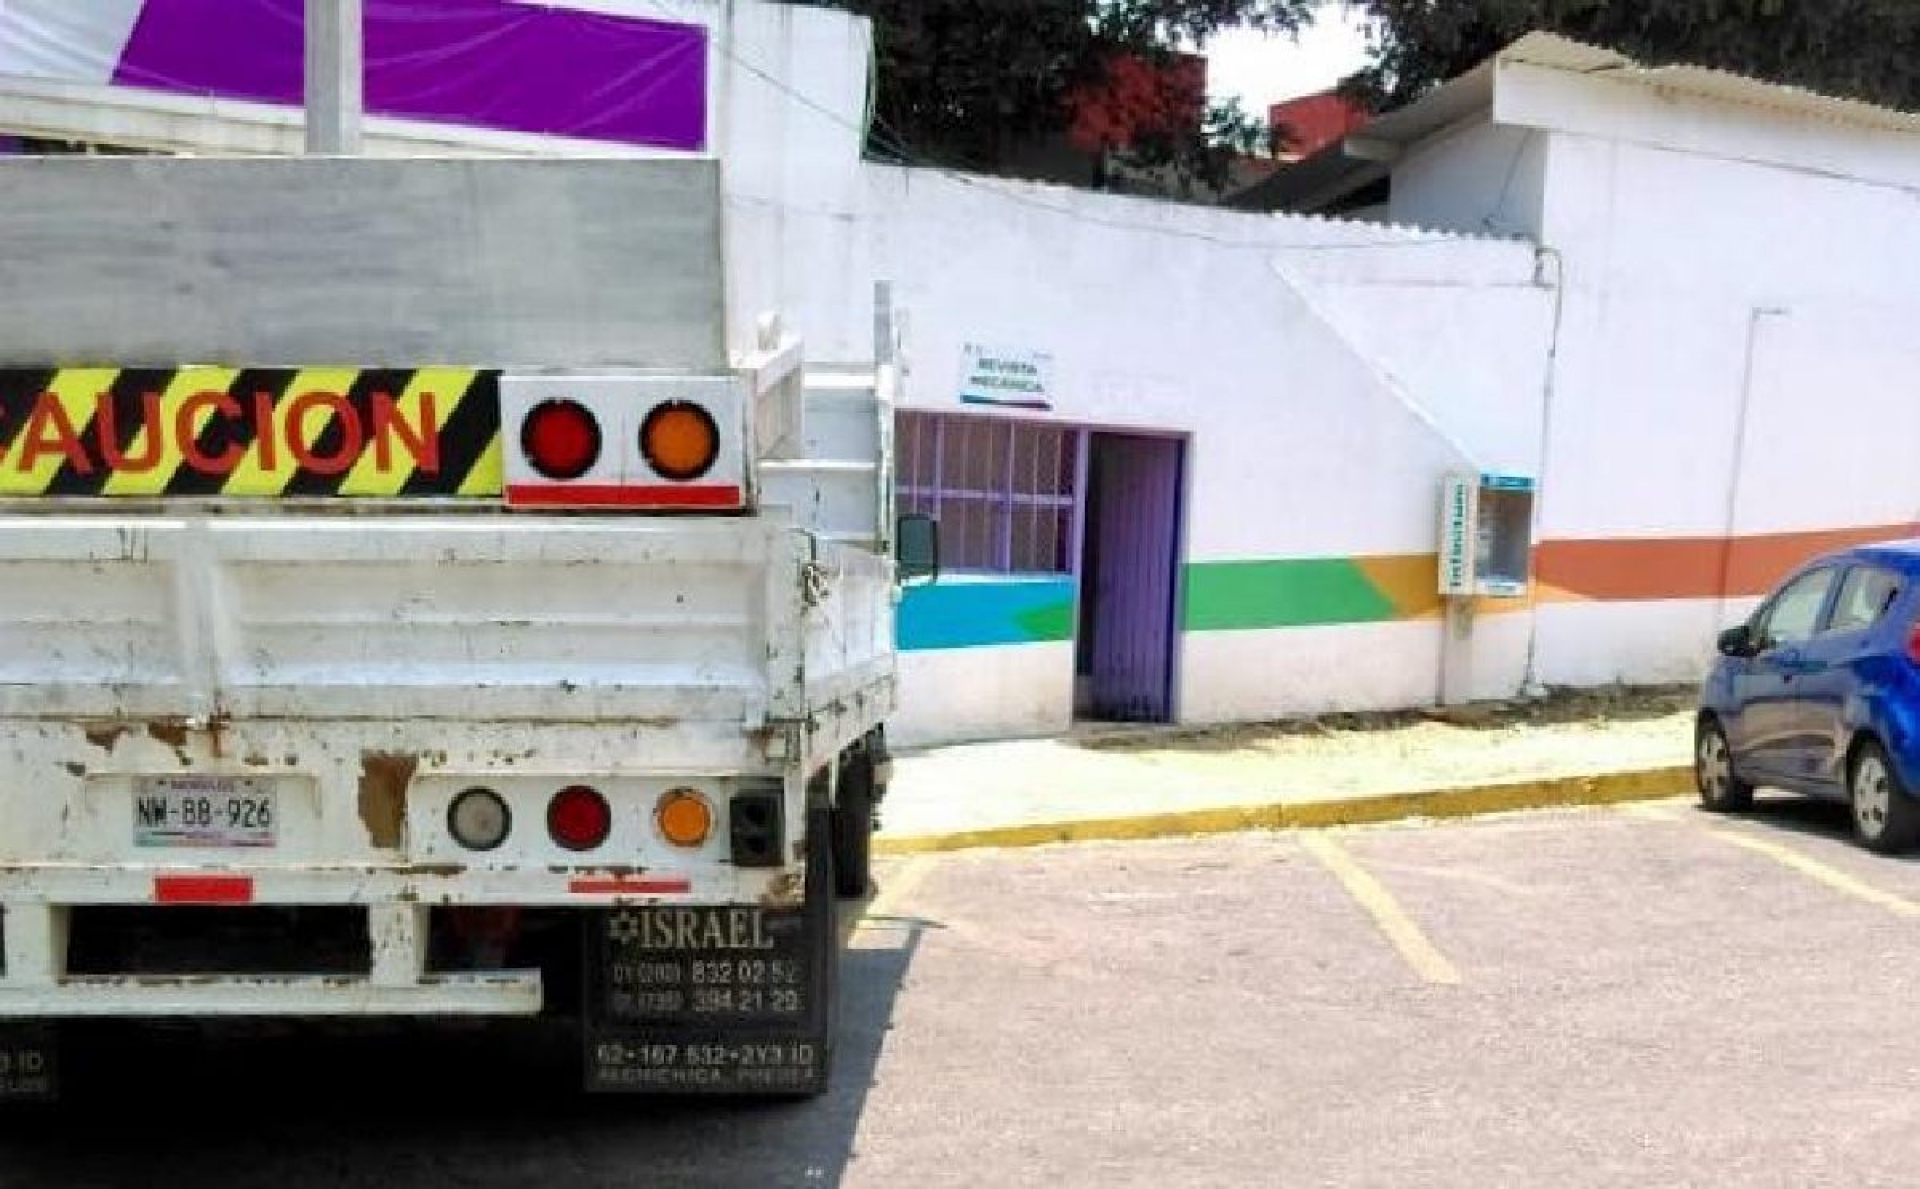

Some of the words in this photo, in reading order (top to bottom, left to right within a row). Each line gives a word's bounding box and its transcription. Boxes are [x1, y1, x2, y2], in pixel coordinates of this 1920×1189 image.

[977, 357, 1037, 376] REVISTA
[0, 390, 441, 475] AUCION
[638, 910, 774, 948] ISRAEL
